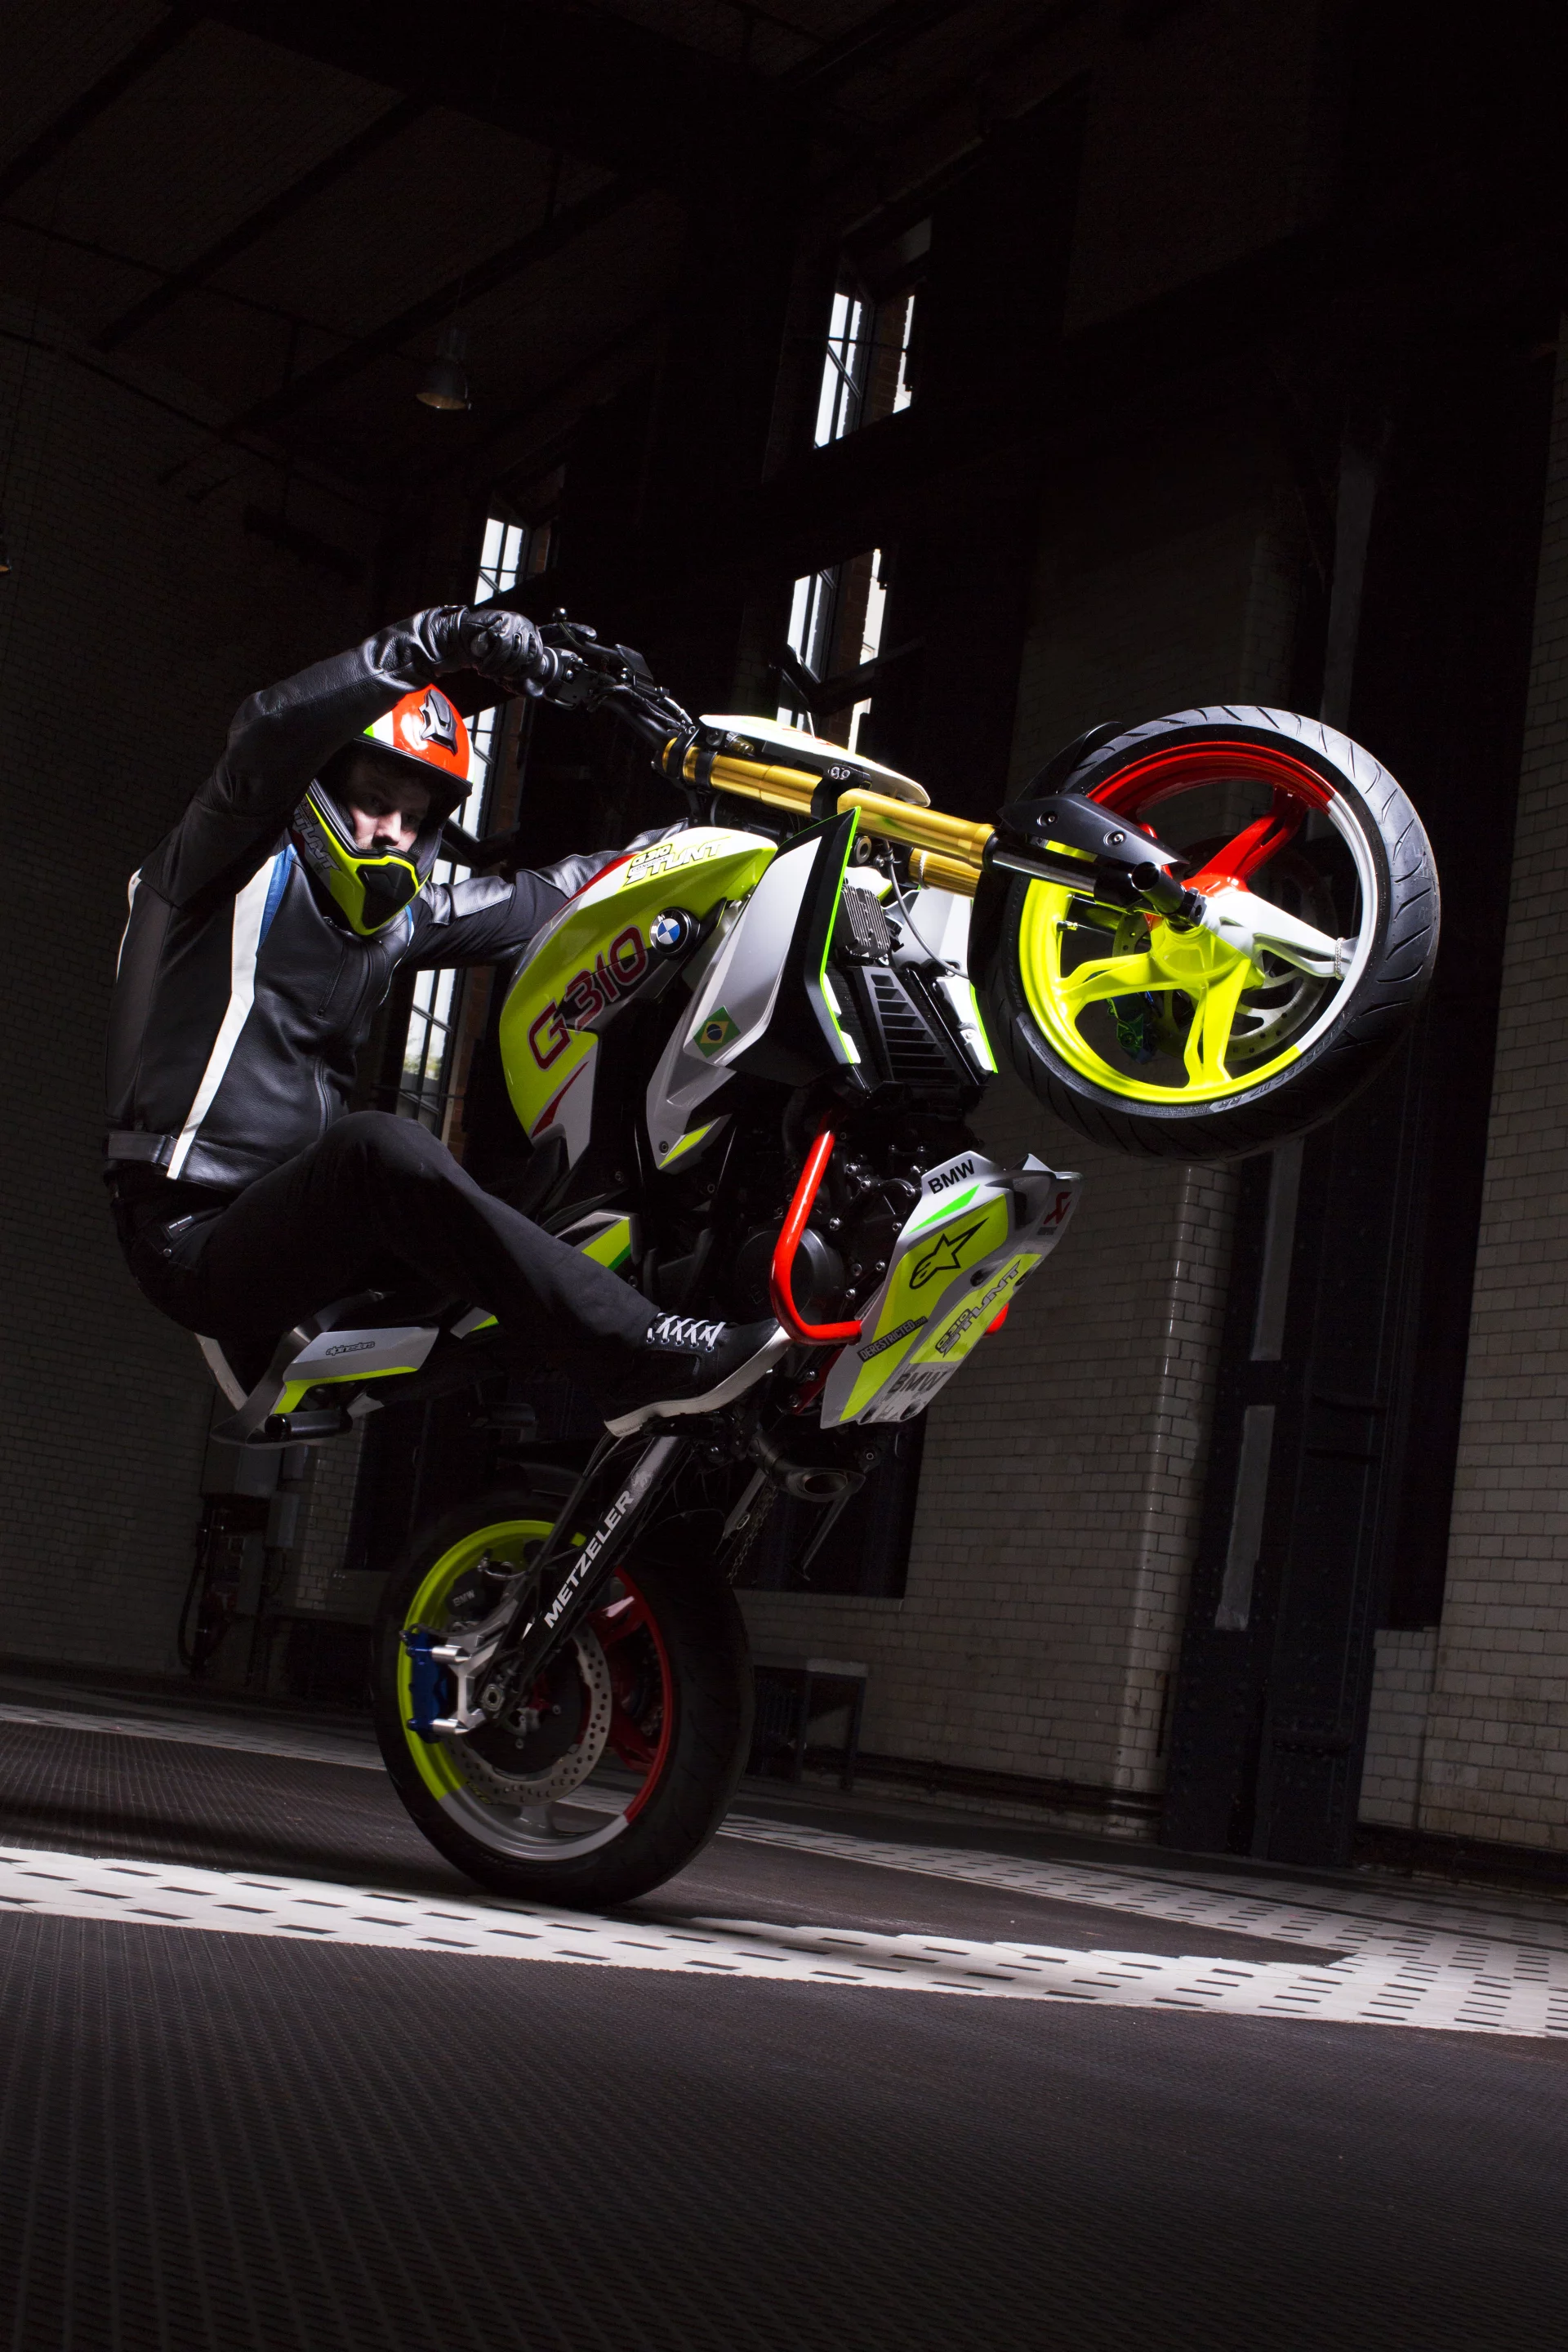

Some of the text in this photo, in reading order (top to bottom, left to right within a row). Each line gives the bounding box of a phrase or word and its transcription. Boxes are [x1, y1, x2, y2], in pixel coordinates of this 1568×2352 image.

[294, 807, 341, 871] TUNT
[623, 836, 730, 887] STUNT
[928, 1159, 975, 1195] BMW
[941, 1259, 1021, 1357] STUNT
[887, 1371, 948, 1393] BMW
[544, 1490, 634, 1629] METZELER
[452, 1589, 475, 1607] BMW
